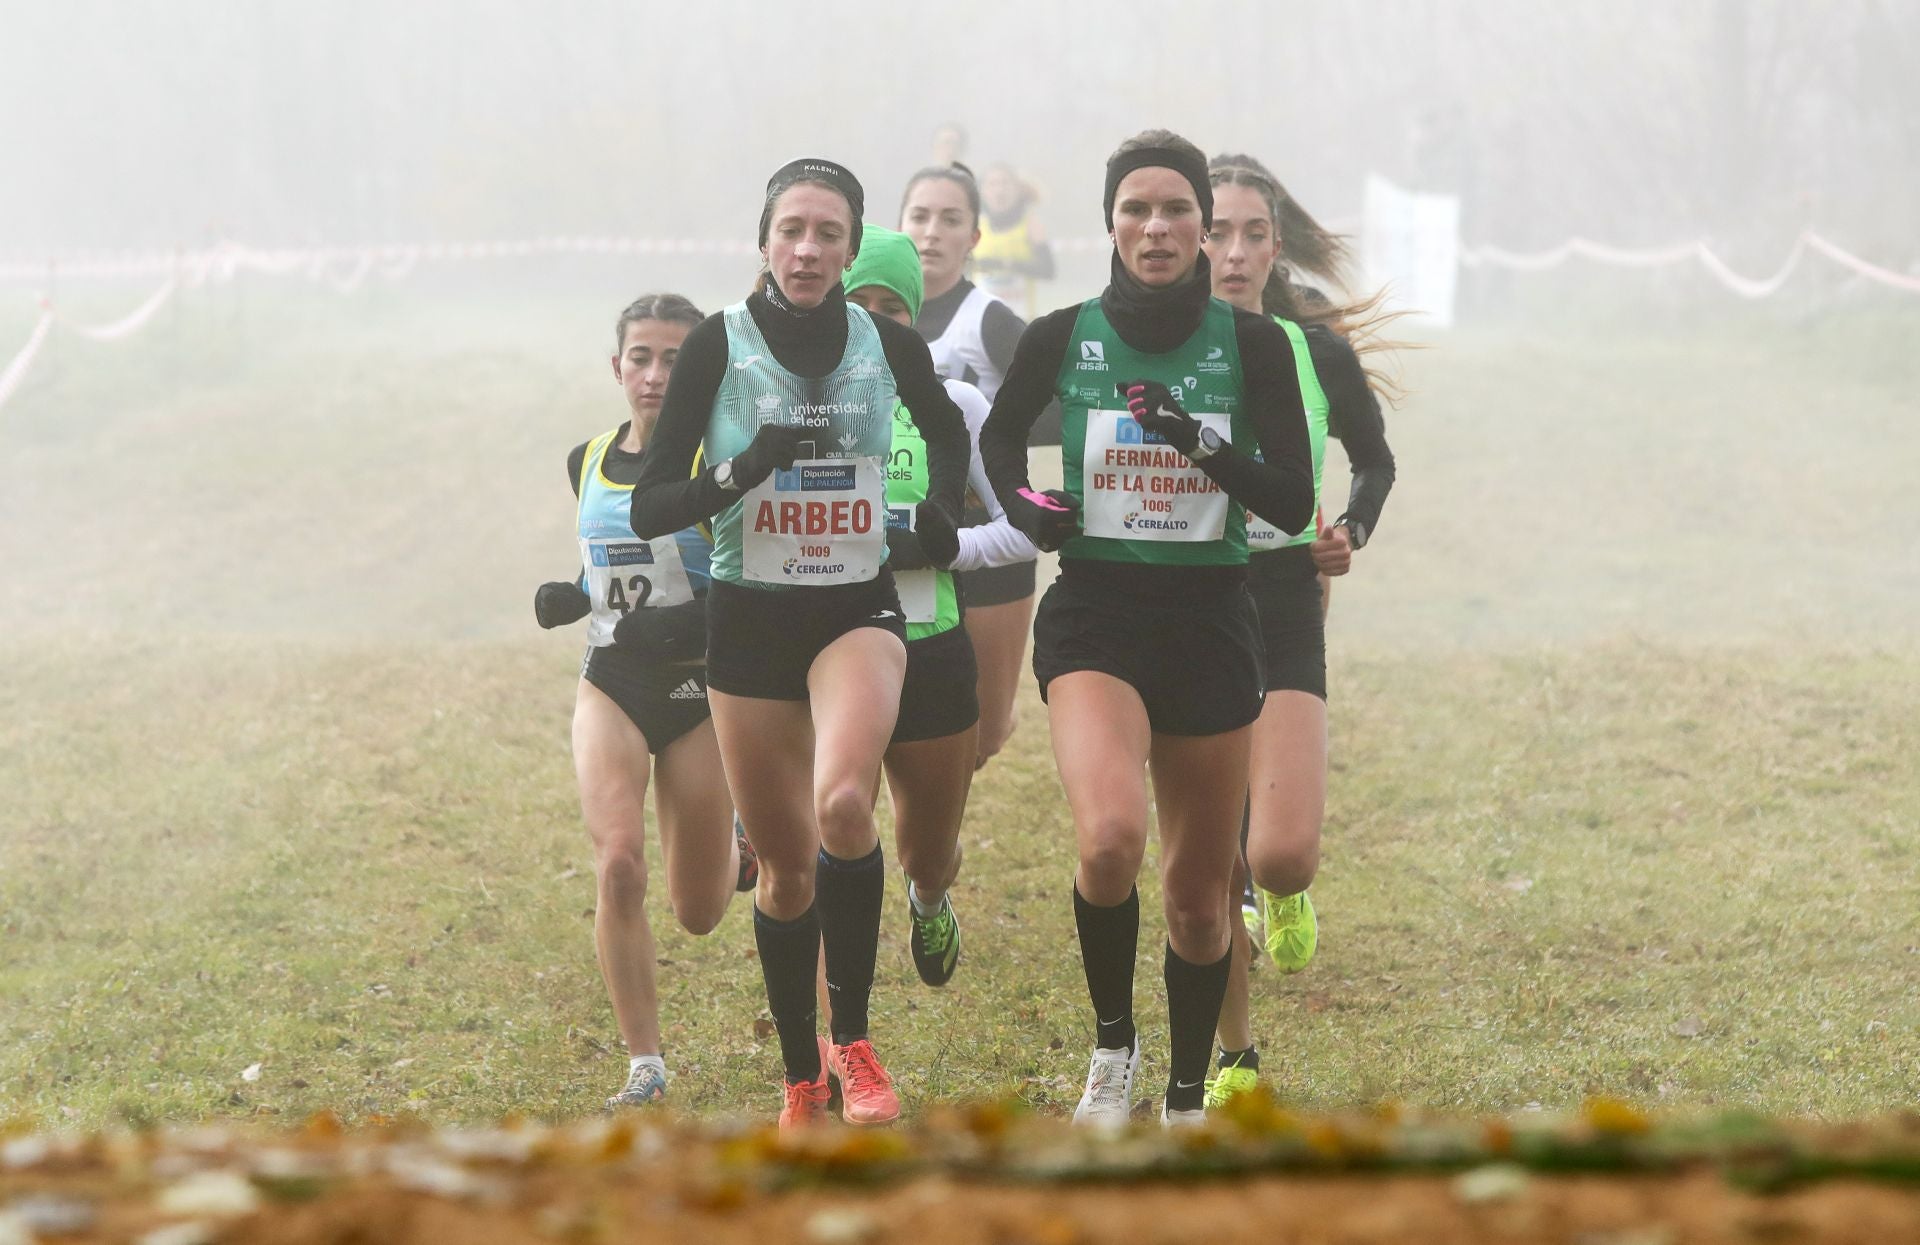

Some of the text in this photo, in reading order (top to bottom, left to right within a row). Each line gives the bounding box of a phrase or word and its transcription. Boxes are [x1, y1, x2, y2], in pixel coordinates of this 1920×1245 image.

[804, 165, 838, 176] KALENJI
[789, 402, 867, 415] universidad
[790, 414, 829, 428] de león
[1104, 446, 1200, 468] FERNÁND
[803, 469, 846, 479] Diputación
[887, 467, 913, 481] tels
[816, 479, 854, 487] PALENCIA
[1093, 473, 1220, 494] DE LA GRANJA
[1141, 499, 1172, 513] 1005
[753, 498, 872, 536] ARBEO
[1137, 518, 1188, 530] CEREALTO
[1246, 531, 1275, 539] EALTO
[608, 547, 642, 555] Diputación
[799, 545, 831, 558] 1009
[796, 563, 845, 575] CEREALTO
[607, 574, 653, 616] 42
[669, 691, 706, 699] adidas
